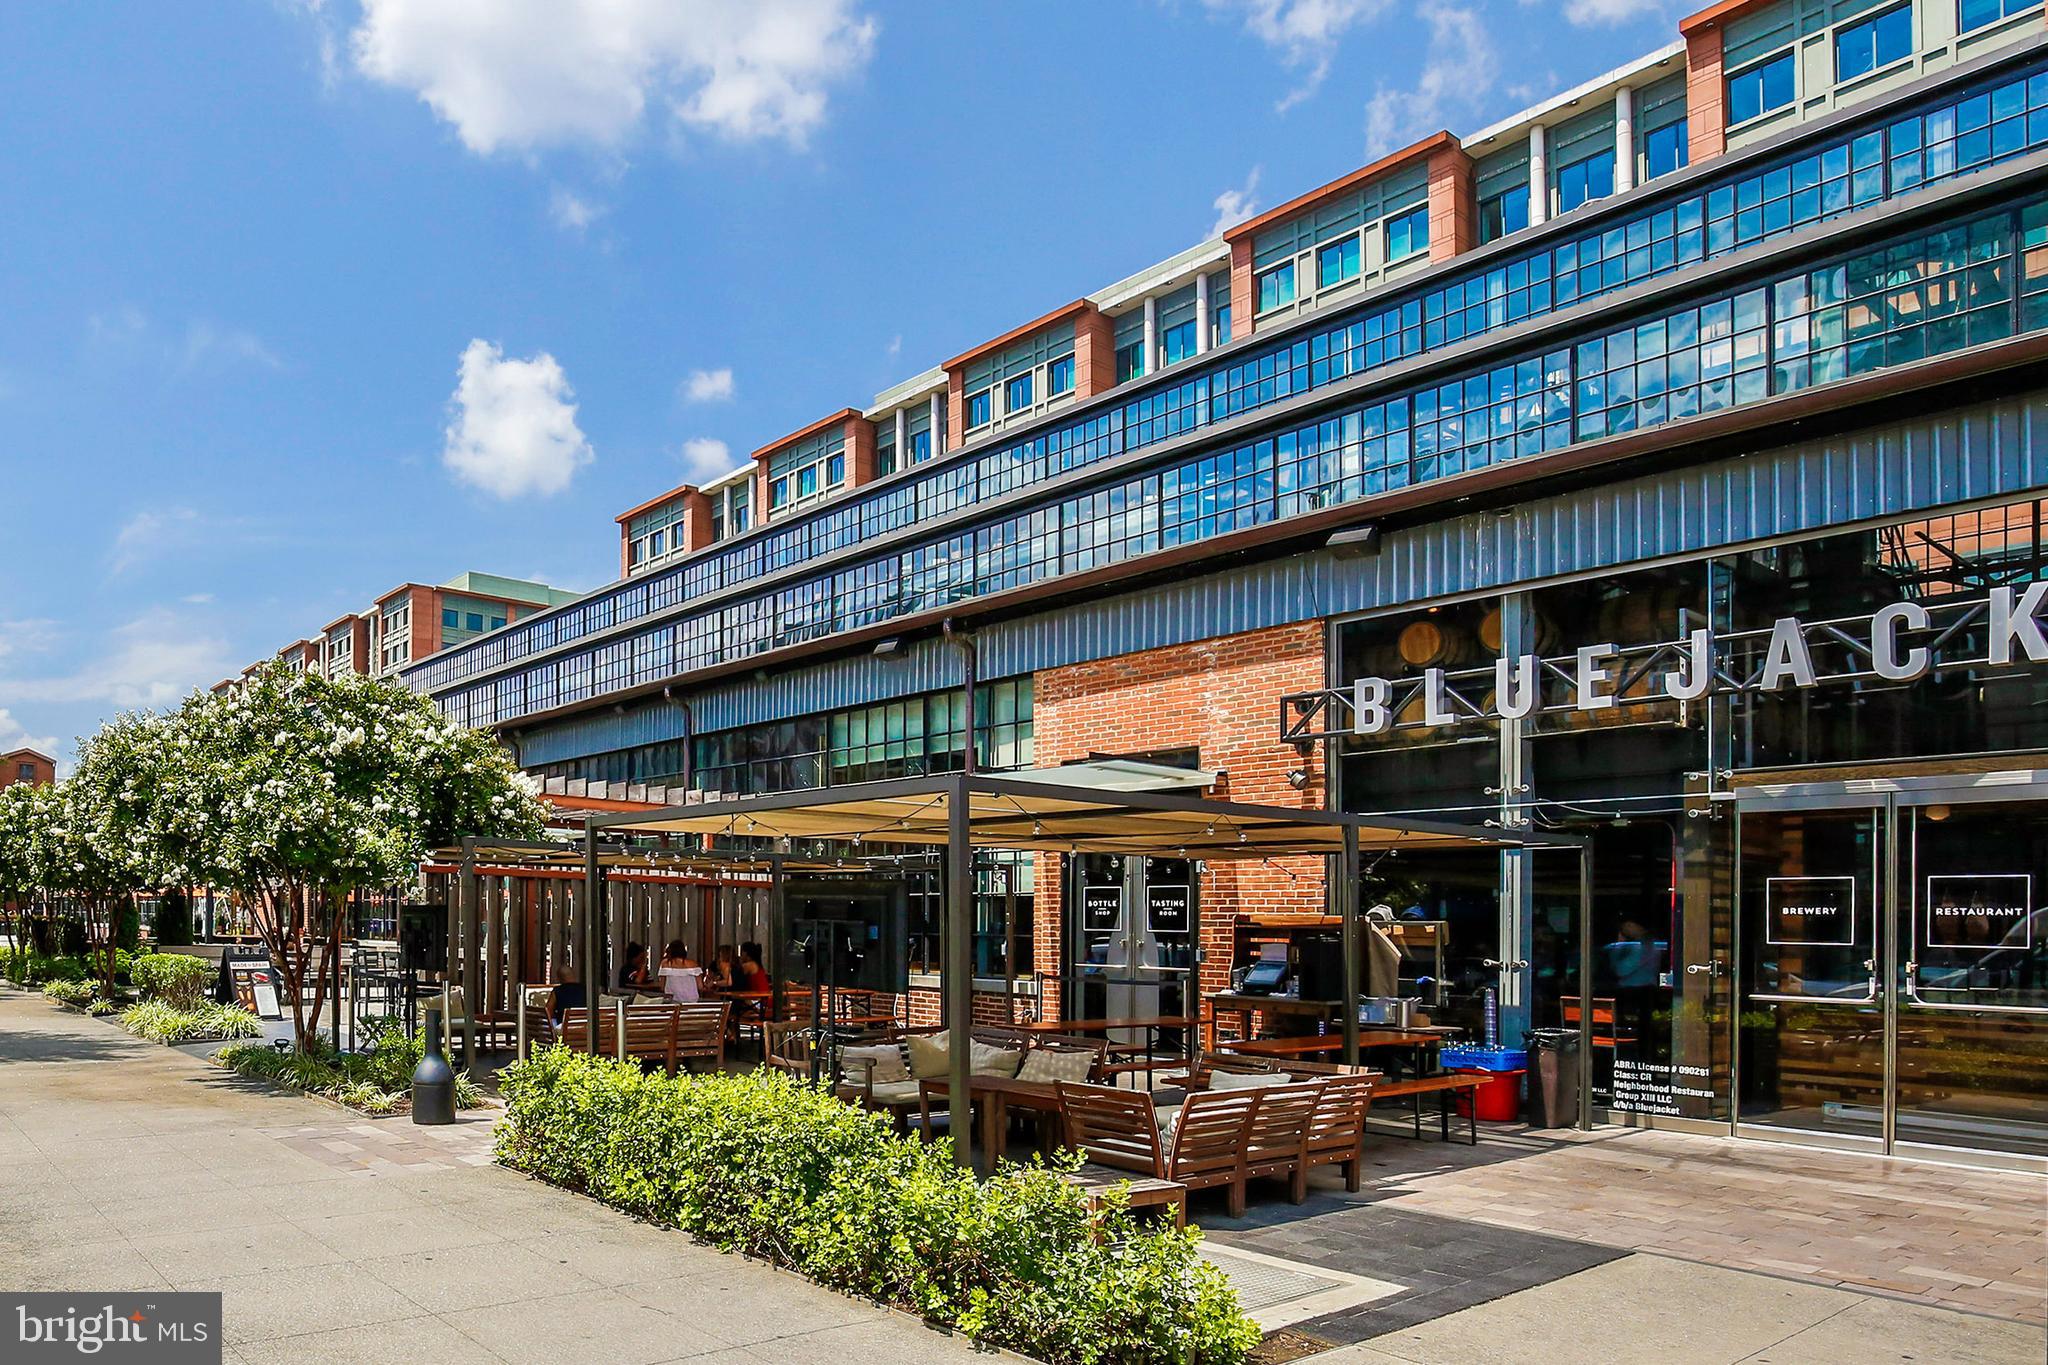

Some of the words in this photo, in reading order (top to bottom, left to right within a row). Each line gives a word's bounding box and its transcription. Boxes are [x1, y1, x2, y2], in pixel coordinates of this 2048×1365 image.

[1354, 580, 2048, 735] BLUEJACK
[1087, 900, 1118, 908] BOTTLE
[1151, 900, 1185, 908] TASTING
[1782, 907, 1837, 915] BREWERY
[1935, 907, 2023, 916] RESTAURANT
[1613, 1060, 1636, 1070] ABRA
[1637, 1062, 1669, 1073] License
[1671, 1065, 1677, 1073] #
[1613, 1070, 1638, 1080] Class:
[1640, 1072, 1652, 1081] CR
[1613, 1080, 1670, 1094] Neighborhood
[1615, 1090, 1640, 1102] Group
[1640, 1093, 1656, 1102] XIII
[1656, 1094, 1673, 1104] LLC
[1613, 1100, 1634, 1110] d/b/a
[1635, 1102, 1680, 1115] Bluejacket
